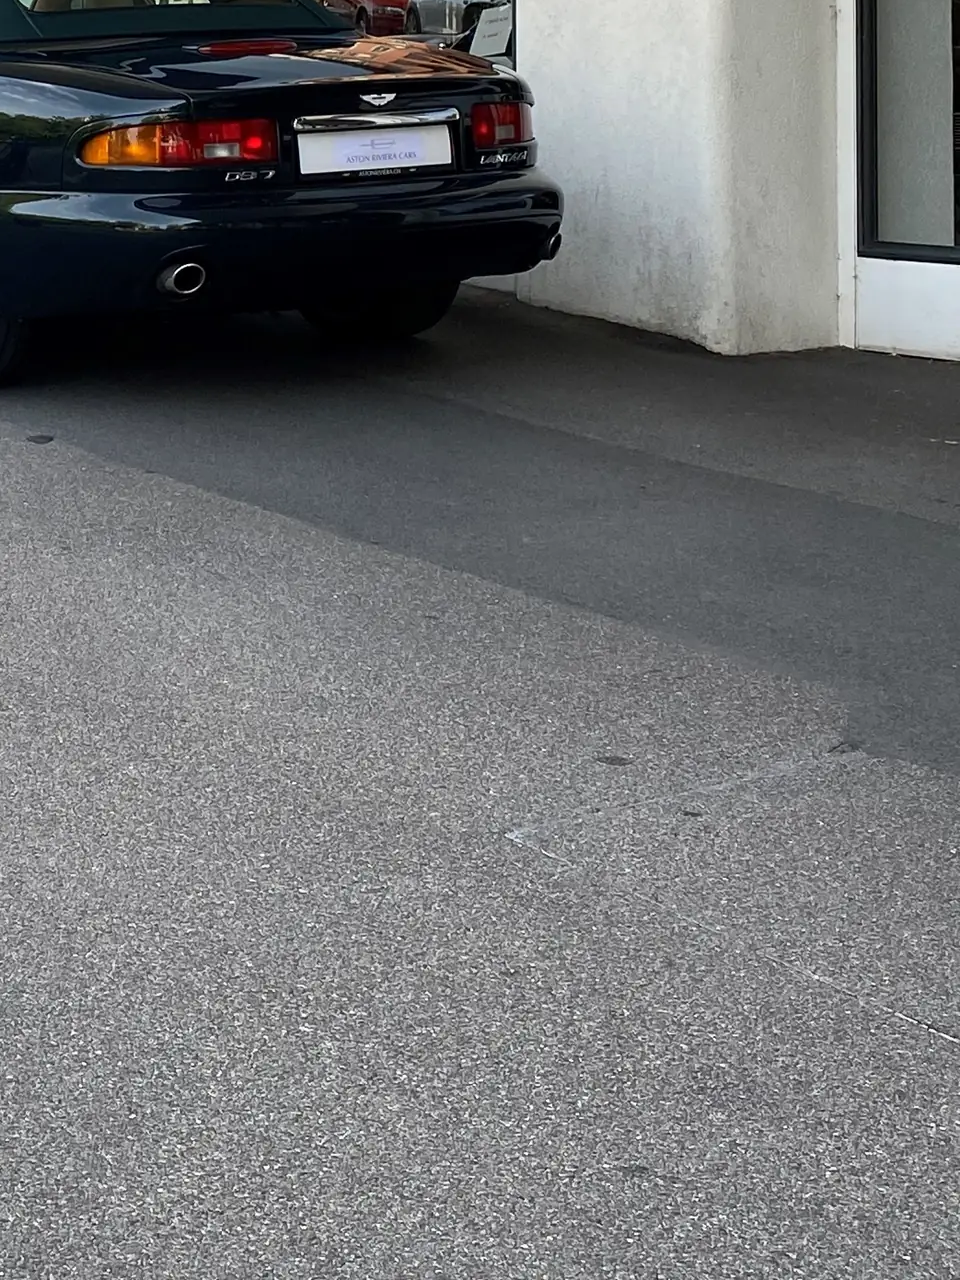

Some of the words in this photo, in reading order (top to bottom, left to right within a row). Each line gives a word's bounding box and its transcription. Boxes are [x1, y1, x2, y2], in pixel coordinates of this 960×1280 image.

[346, 155, 370, 163] ASTON
[372, 153, 397, 161] RIVIERA
[399, 151, 417, 159] CARS
